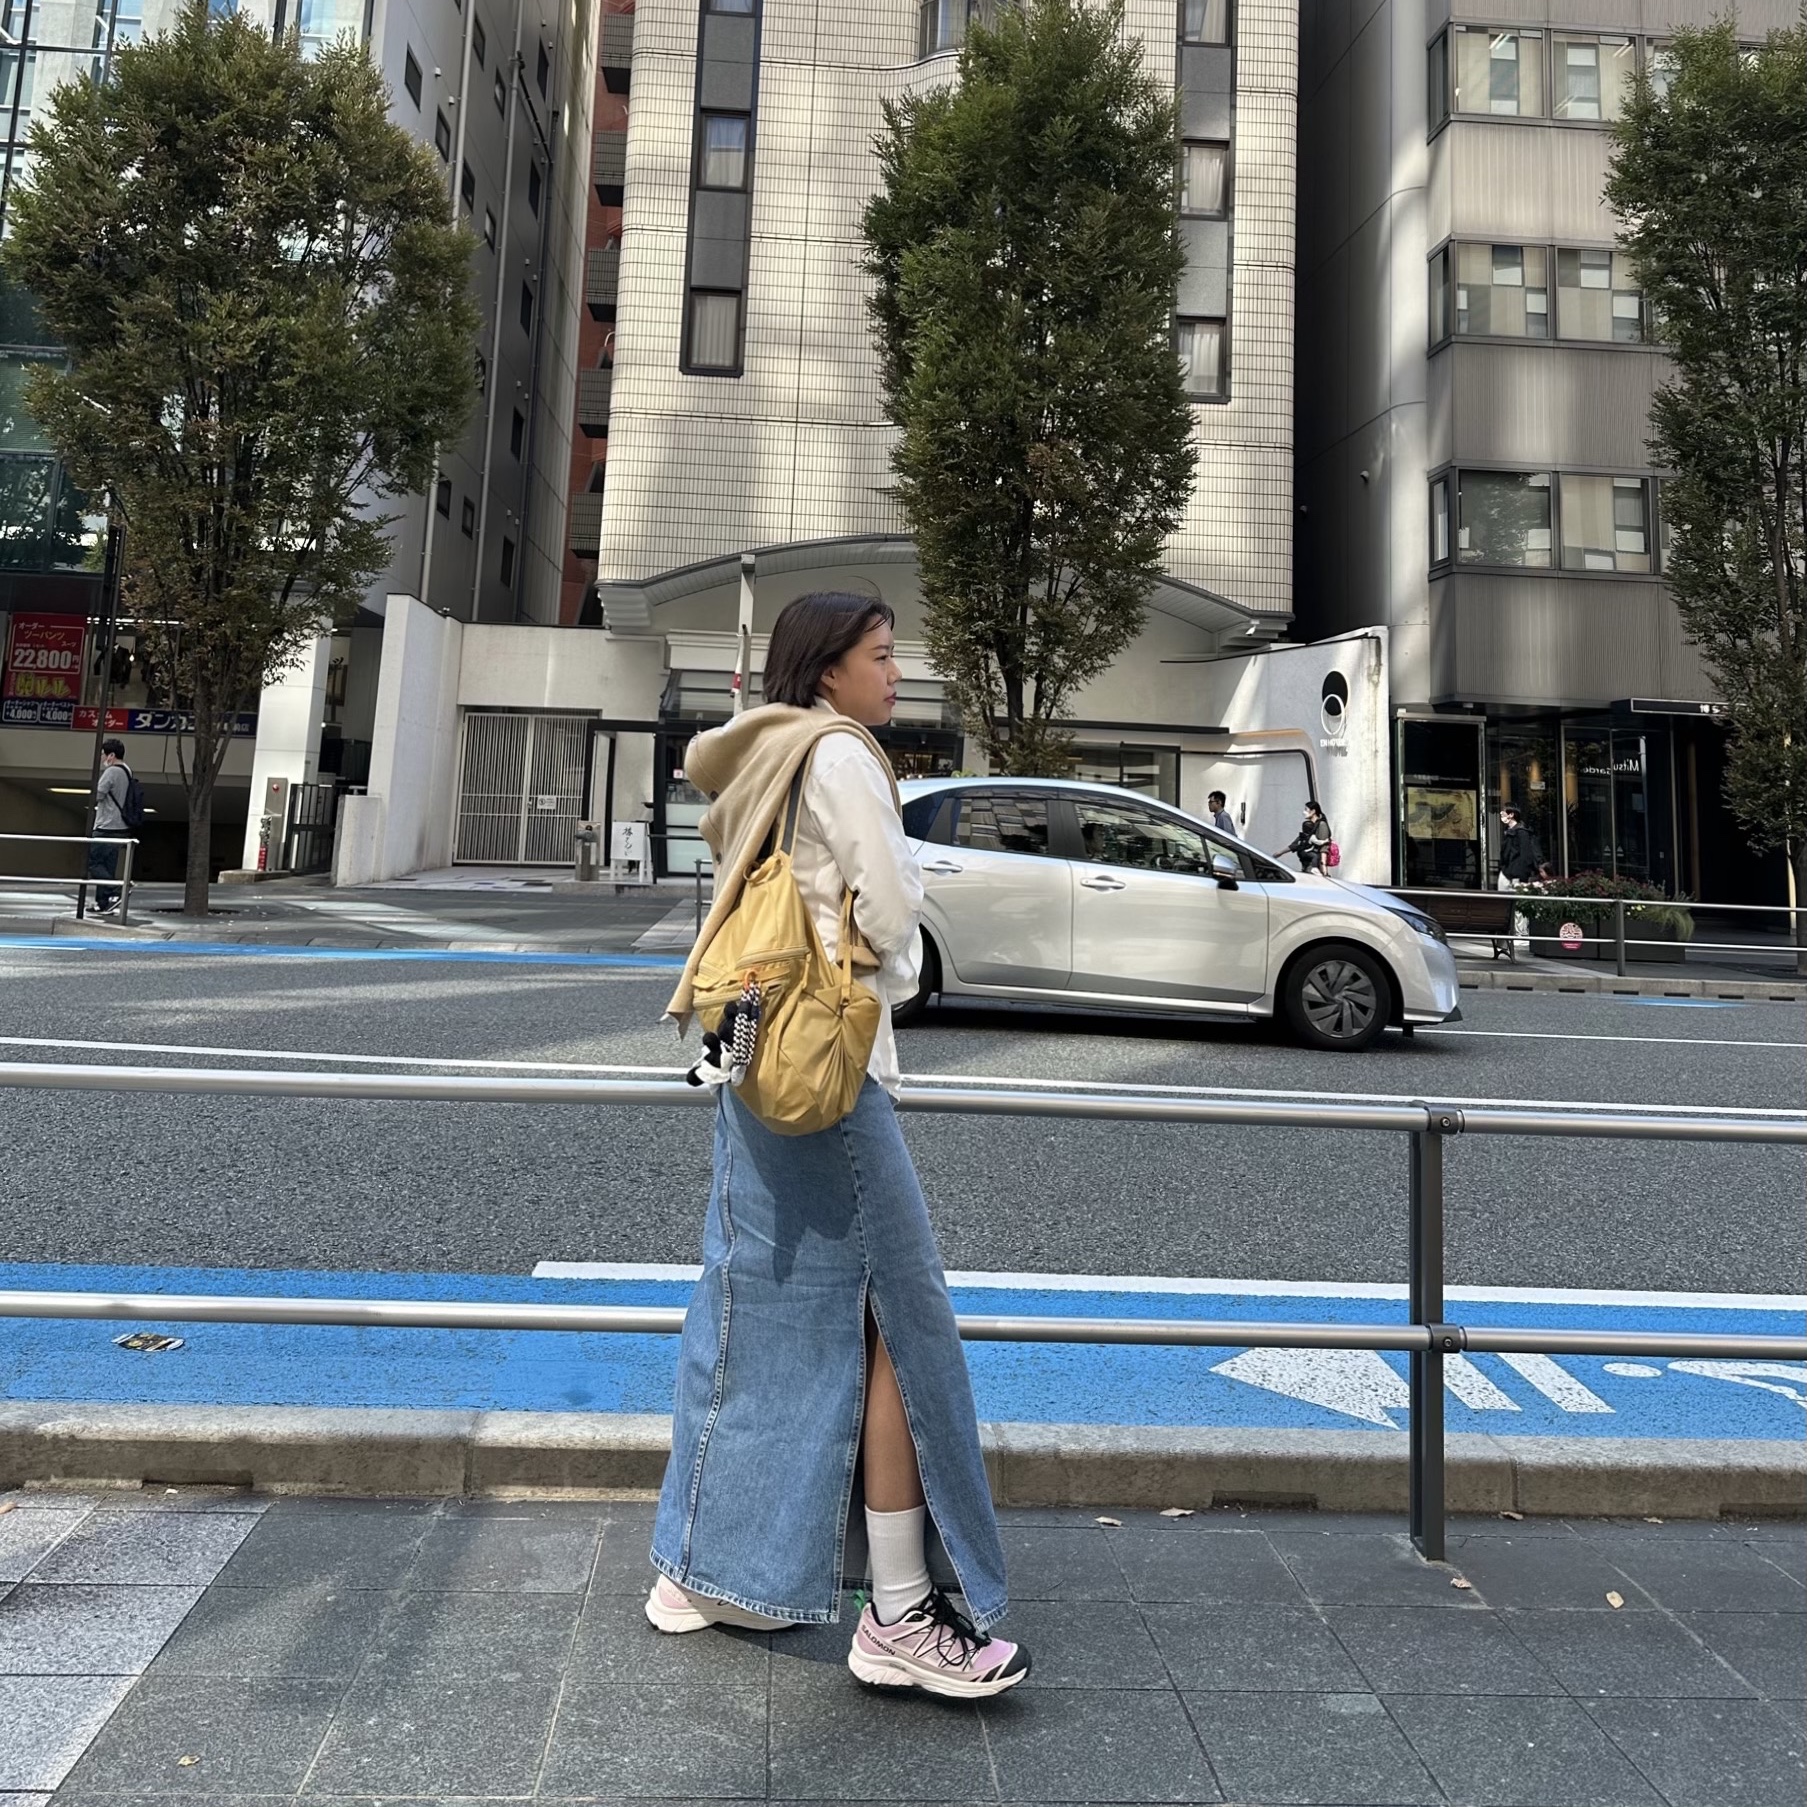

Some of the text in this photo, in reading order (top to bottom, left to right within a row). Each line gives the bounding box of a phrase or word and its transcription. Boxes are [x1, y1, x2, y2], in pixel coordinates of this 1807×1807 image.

[19, 621, 45, 630] オーダー
[79, 710, 113, 719] カスム
[92, 719, 123, 728] オダー
[861, 1624, 896, 1656] SALOMON
